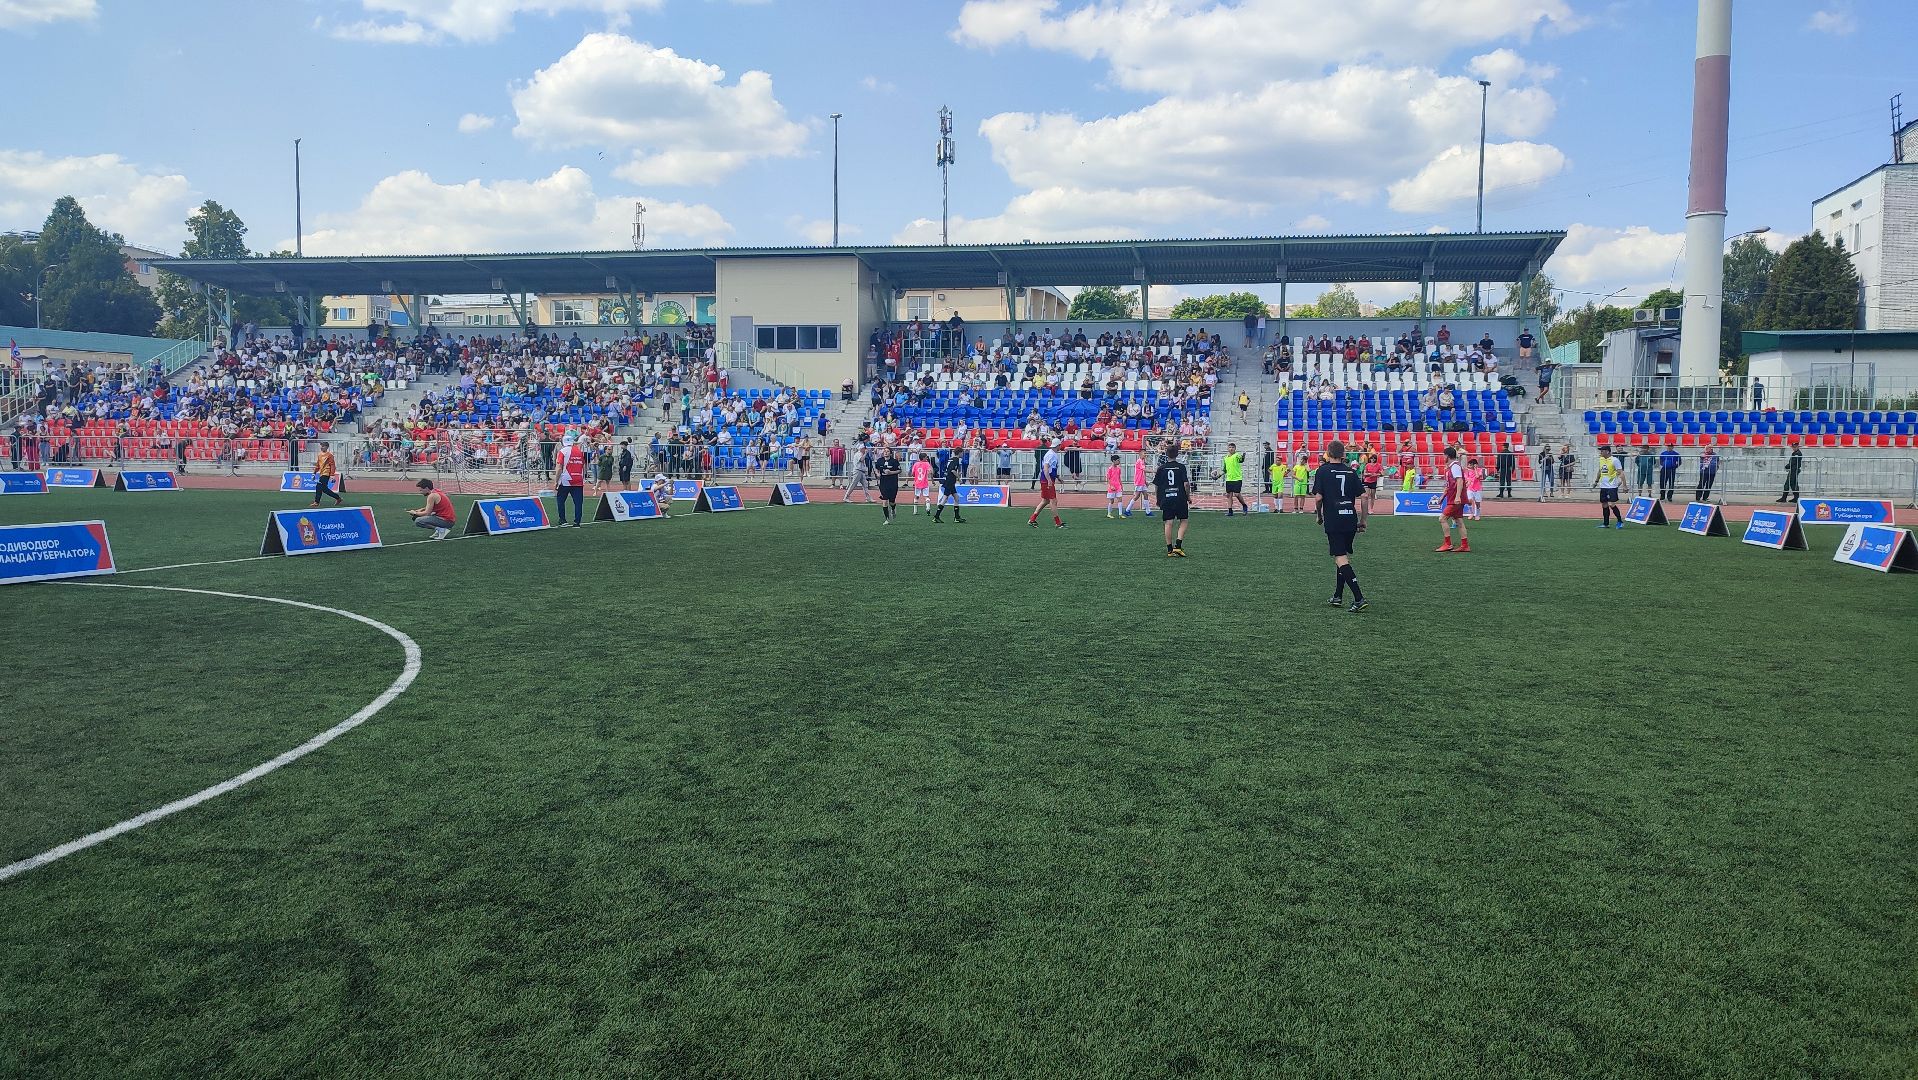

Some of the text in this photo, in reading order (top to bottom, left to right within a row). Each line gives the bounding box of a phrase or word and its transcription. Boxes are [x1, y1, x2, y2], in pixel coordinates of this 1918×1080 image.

[1167, 469, 1175, 486] 9
[1335, 474, 1346, 497] 7
[317, 522, 345, 531] Команда
[320, 531, 360, 542] Губернатора
